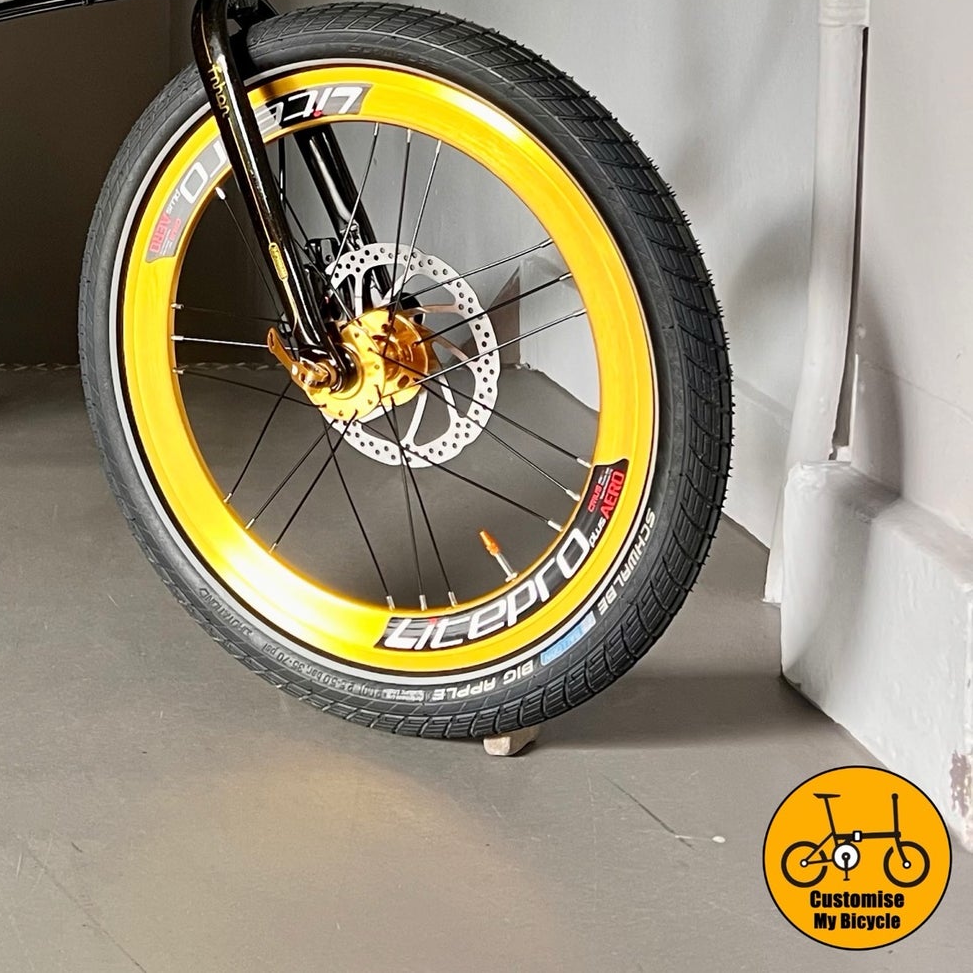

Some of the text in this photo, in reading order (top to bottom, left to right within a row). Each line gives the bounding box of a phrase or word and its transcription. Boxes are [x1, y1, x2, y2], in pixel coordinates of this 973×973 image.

[600, 470, 625, 520] AERO
[598, 508, 656, 616] SCHWALBE
[432, 677, 496, 701] APPLE
[503, 659, 534, 685] BIG
